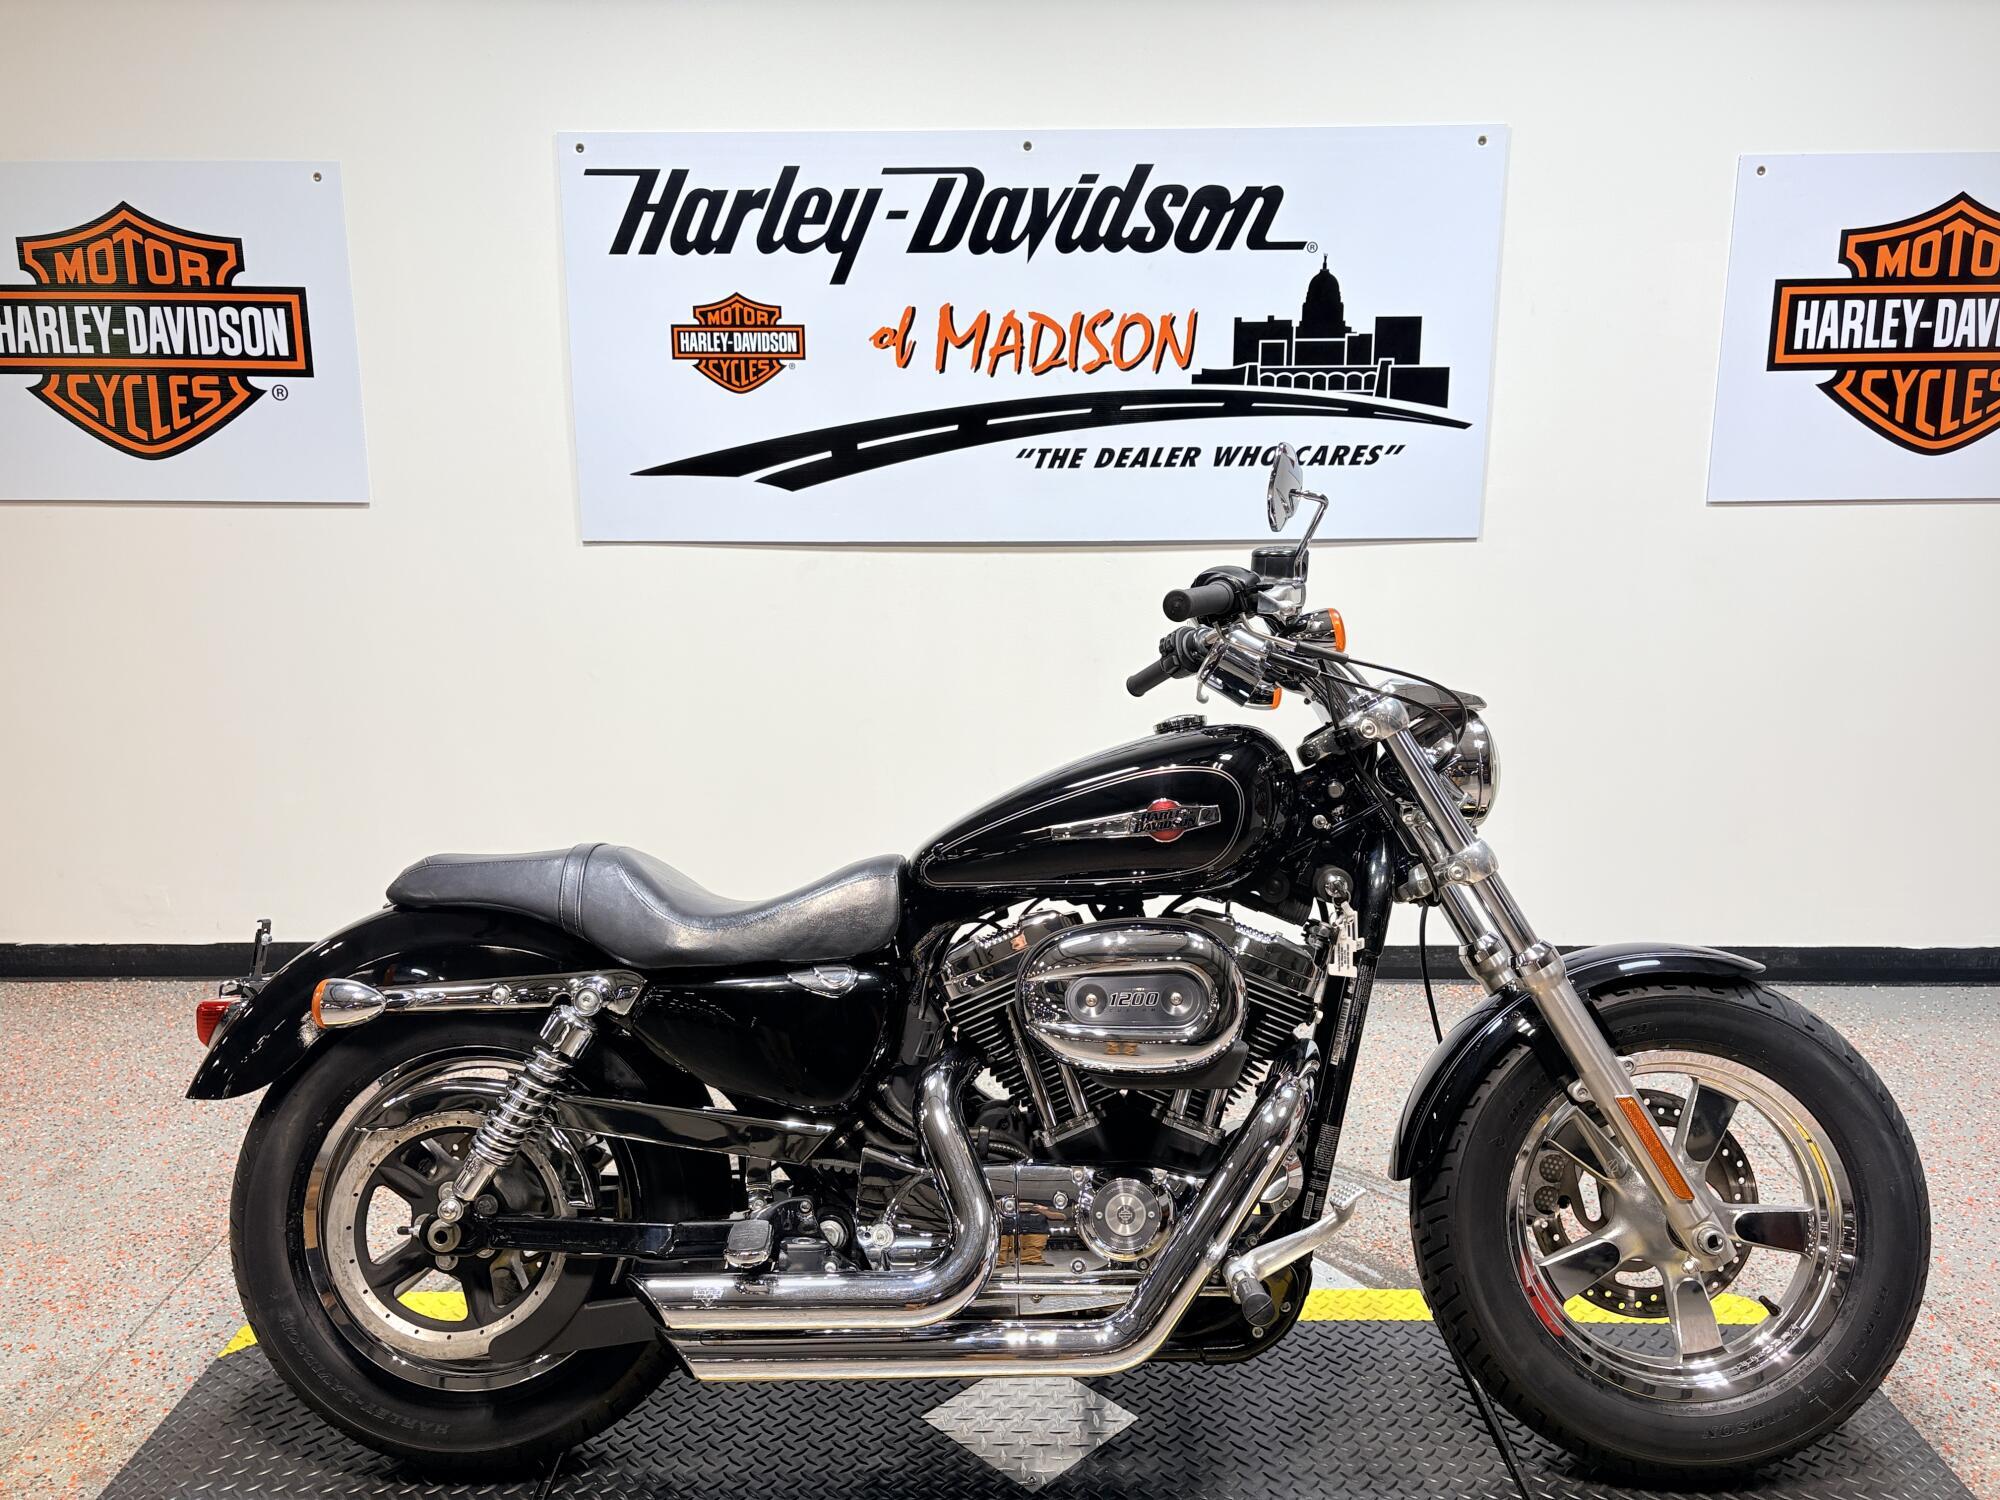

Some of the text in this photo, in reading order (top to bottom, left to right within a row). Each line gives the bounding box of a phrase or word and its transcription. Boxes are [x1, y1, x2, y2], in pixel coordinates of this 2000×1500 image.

[584, 163, 1307, 285] Harley-Davidson
[54, 226, 211, 287] MOTOR
[0, 305, 290, 357] HARLEY-DAVIDSON
[707, 302, 769, 326] MOTOR
[679, 331, 798, 353] HARLEY-DAVIDSON
[935, 302, 1199, 378] MADISON
[708, 359, 770, 387] CYCLES
[67, 374, 222, 442] CYCLES
[1093, 446, 1202, 469] DEALER
[1212, 445, 1277, 468] WHO
[1109, 991, 1159, 1007] 1200
